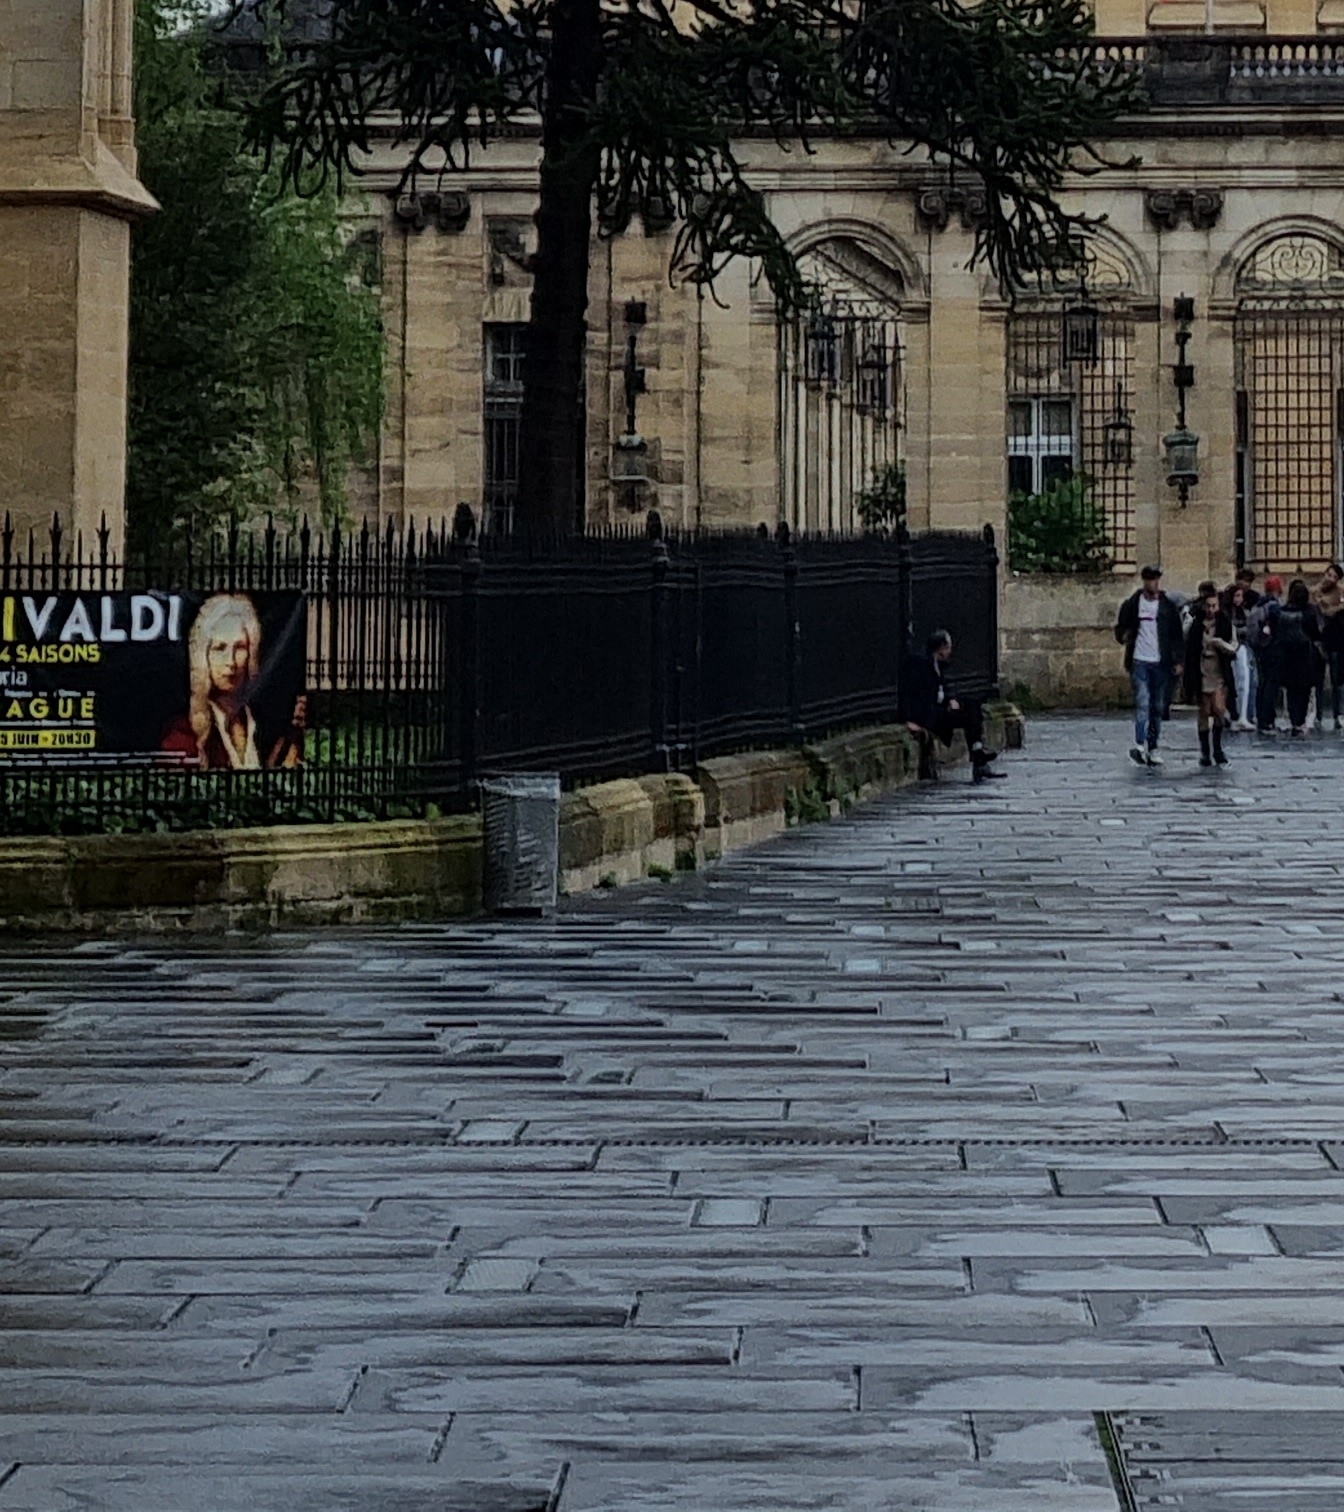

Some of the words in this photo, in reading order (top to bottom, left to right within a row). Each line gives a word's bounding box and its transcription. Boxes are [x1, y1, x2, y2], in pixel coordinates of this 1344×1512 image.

[16, 643, 101, 663] SAISONS
[12, 732, 39, 746] JUIN
[51, 731, 92, 746] 20H30
